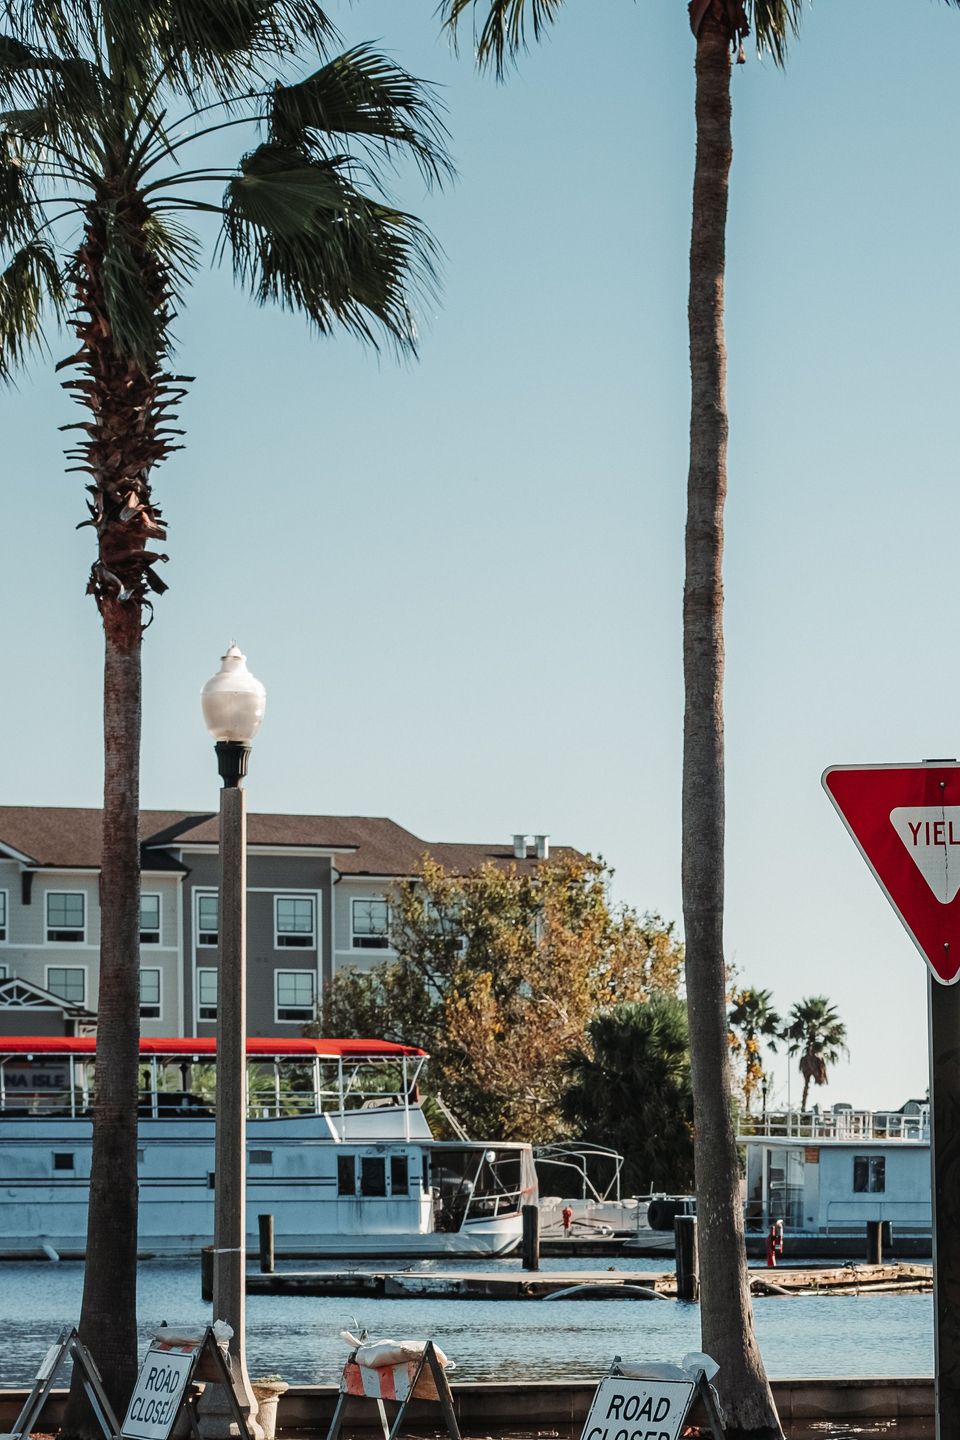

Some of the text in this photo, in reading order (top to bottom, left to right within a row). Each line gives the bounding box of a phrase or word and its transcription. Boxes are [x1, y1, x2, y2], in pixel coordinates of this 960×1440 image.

[32, 1074, 65, 1088] ISLE
[145, 1366, 180, 1394] ROAD
[130, 1396, 175, 1426] CLOSED
[606, 1394, 671, 1423] ROAD
